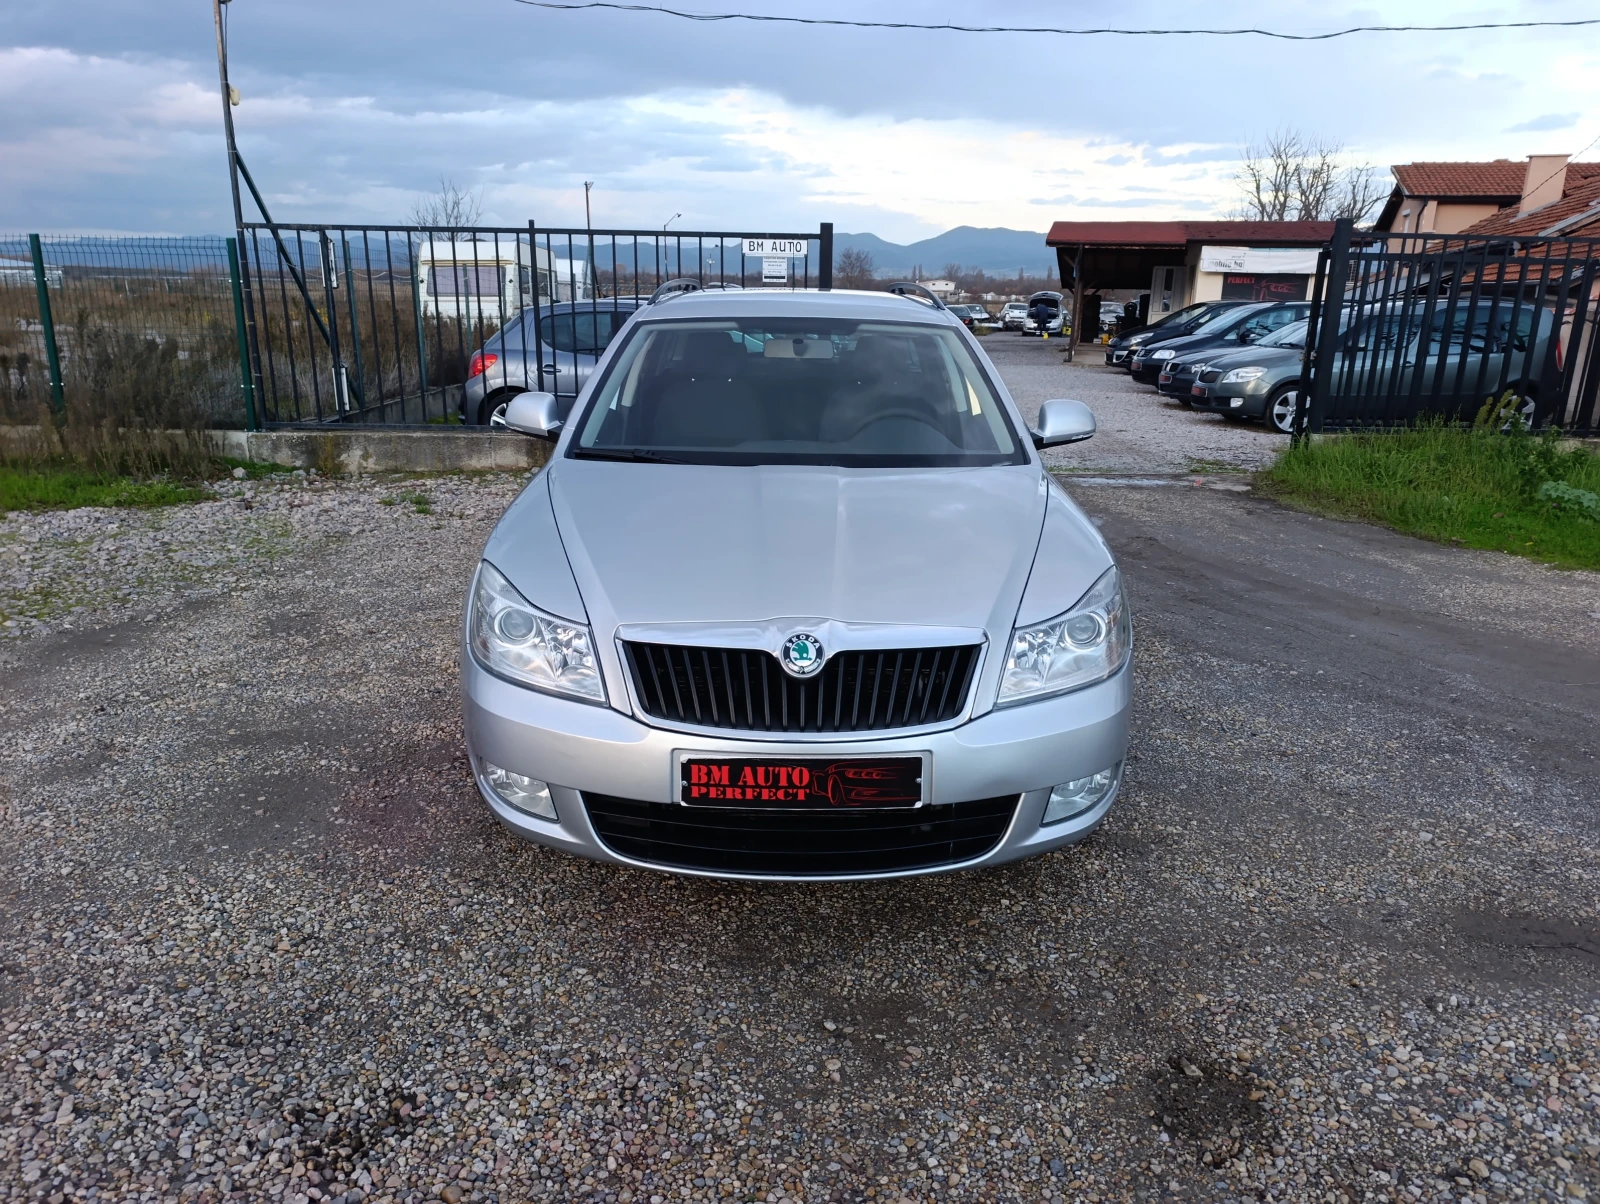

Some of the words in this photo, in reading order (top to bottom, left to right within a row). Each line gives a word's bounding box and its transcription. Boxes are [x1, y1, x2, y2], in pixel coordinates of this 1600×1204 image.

[748, 241, 764, 252] BM
[771, 242, 802, 252] AUTO
[1227, 276, 1256, 284] PERFECT
[690, 764, 730, 785] BM
[738, 767, 810, 786] AUTO
[690, 786, 810, 800] PERFECT
